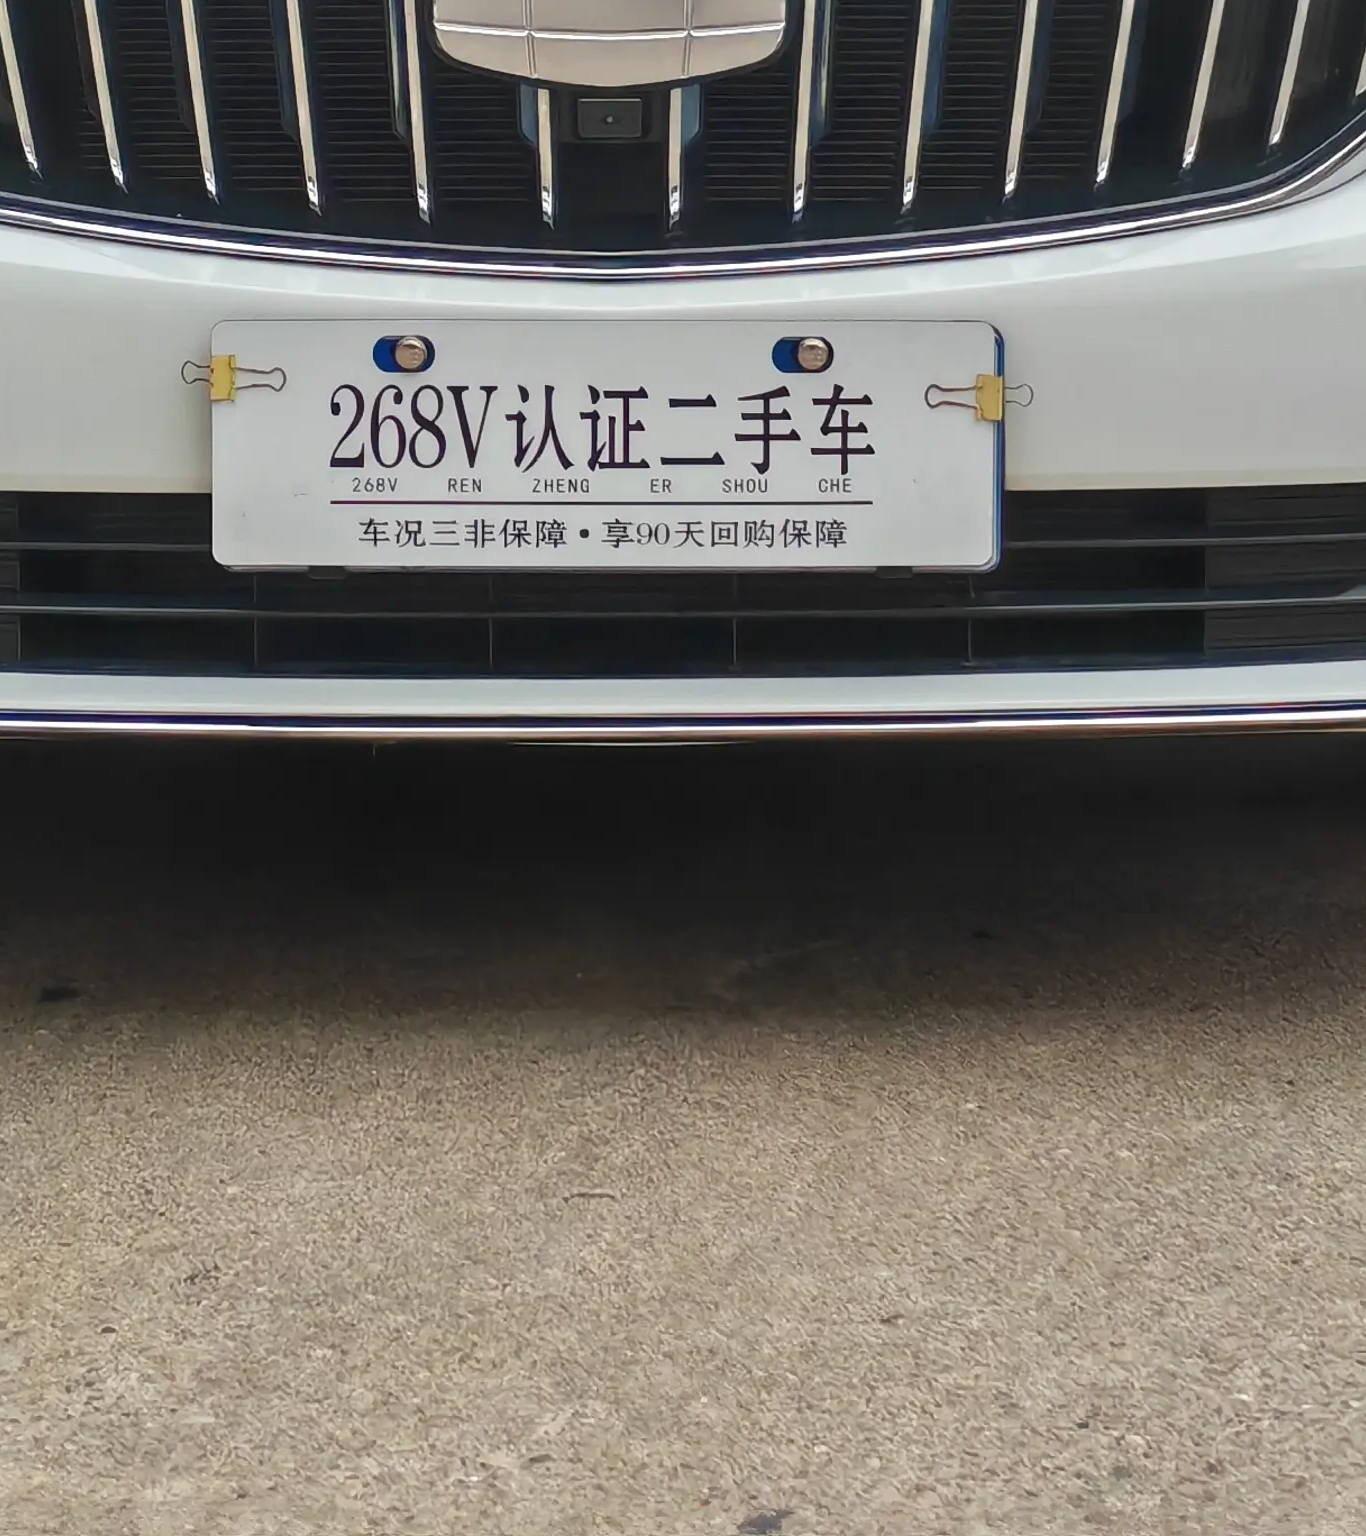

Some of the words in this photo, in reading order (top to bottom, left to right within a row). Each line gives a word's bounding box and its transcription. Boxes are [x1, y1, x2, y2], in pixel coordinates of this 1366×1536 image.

[329, 383, 876, 475] 268V认证二手车
[351, 476, 399, 494] 268V
[446, 477, 483, 494] REN
[531, 477, 591, 494] ZHENG
[649, 477, 673, 494] ER
[721, 477, 769, 494] SHOU
[817, 477, 853, 494] CHE
